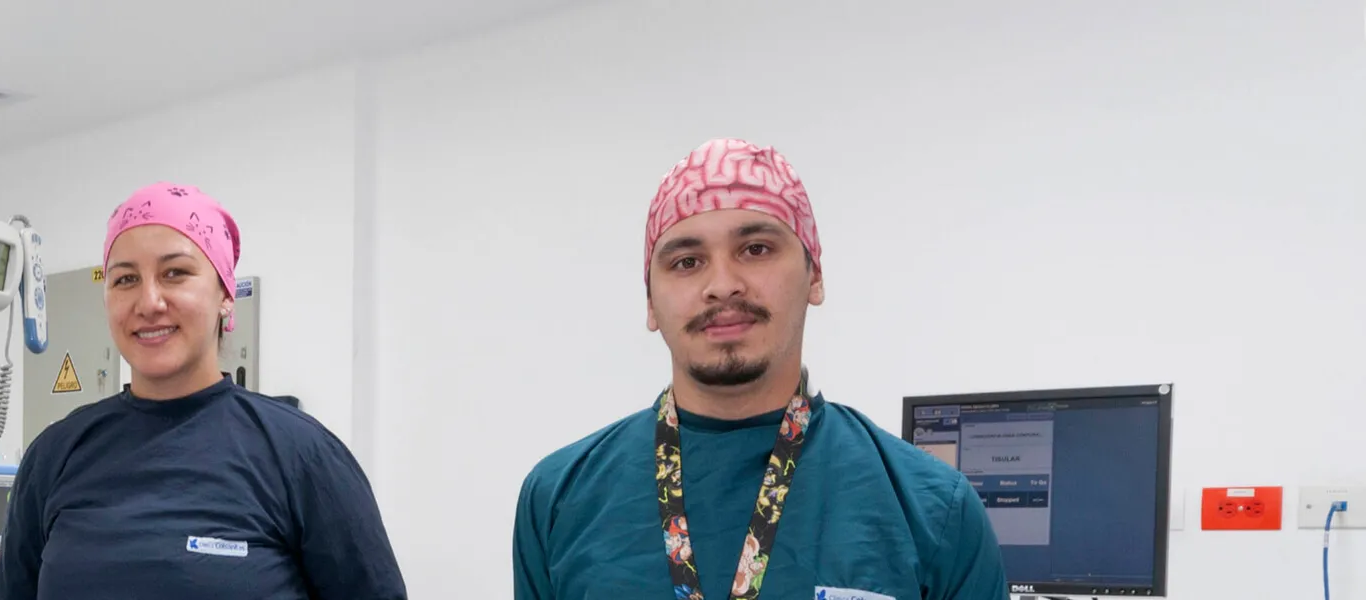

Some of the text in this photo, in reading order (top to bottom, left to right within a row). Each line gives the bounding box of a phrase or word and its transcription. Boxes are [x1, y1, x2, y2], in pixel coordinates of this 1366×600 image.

[57, 382, 77, 390] PELIGRO
[991, 455, 1021, 463] TISULAR
[1011, 584, 1035, 593] DELL
